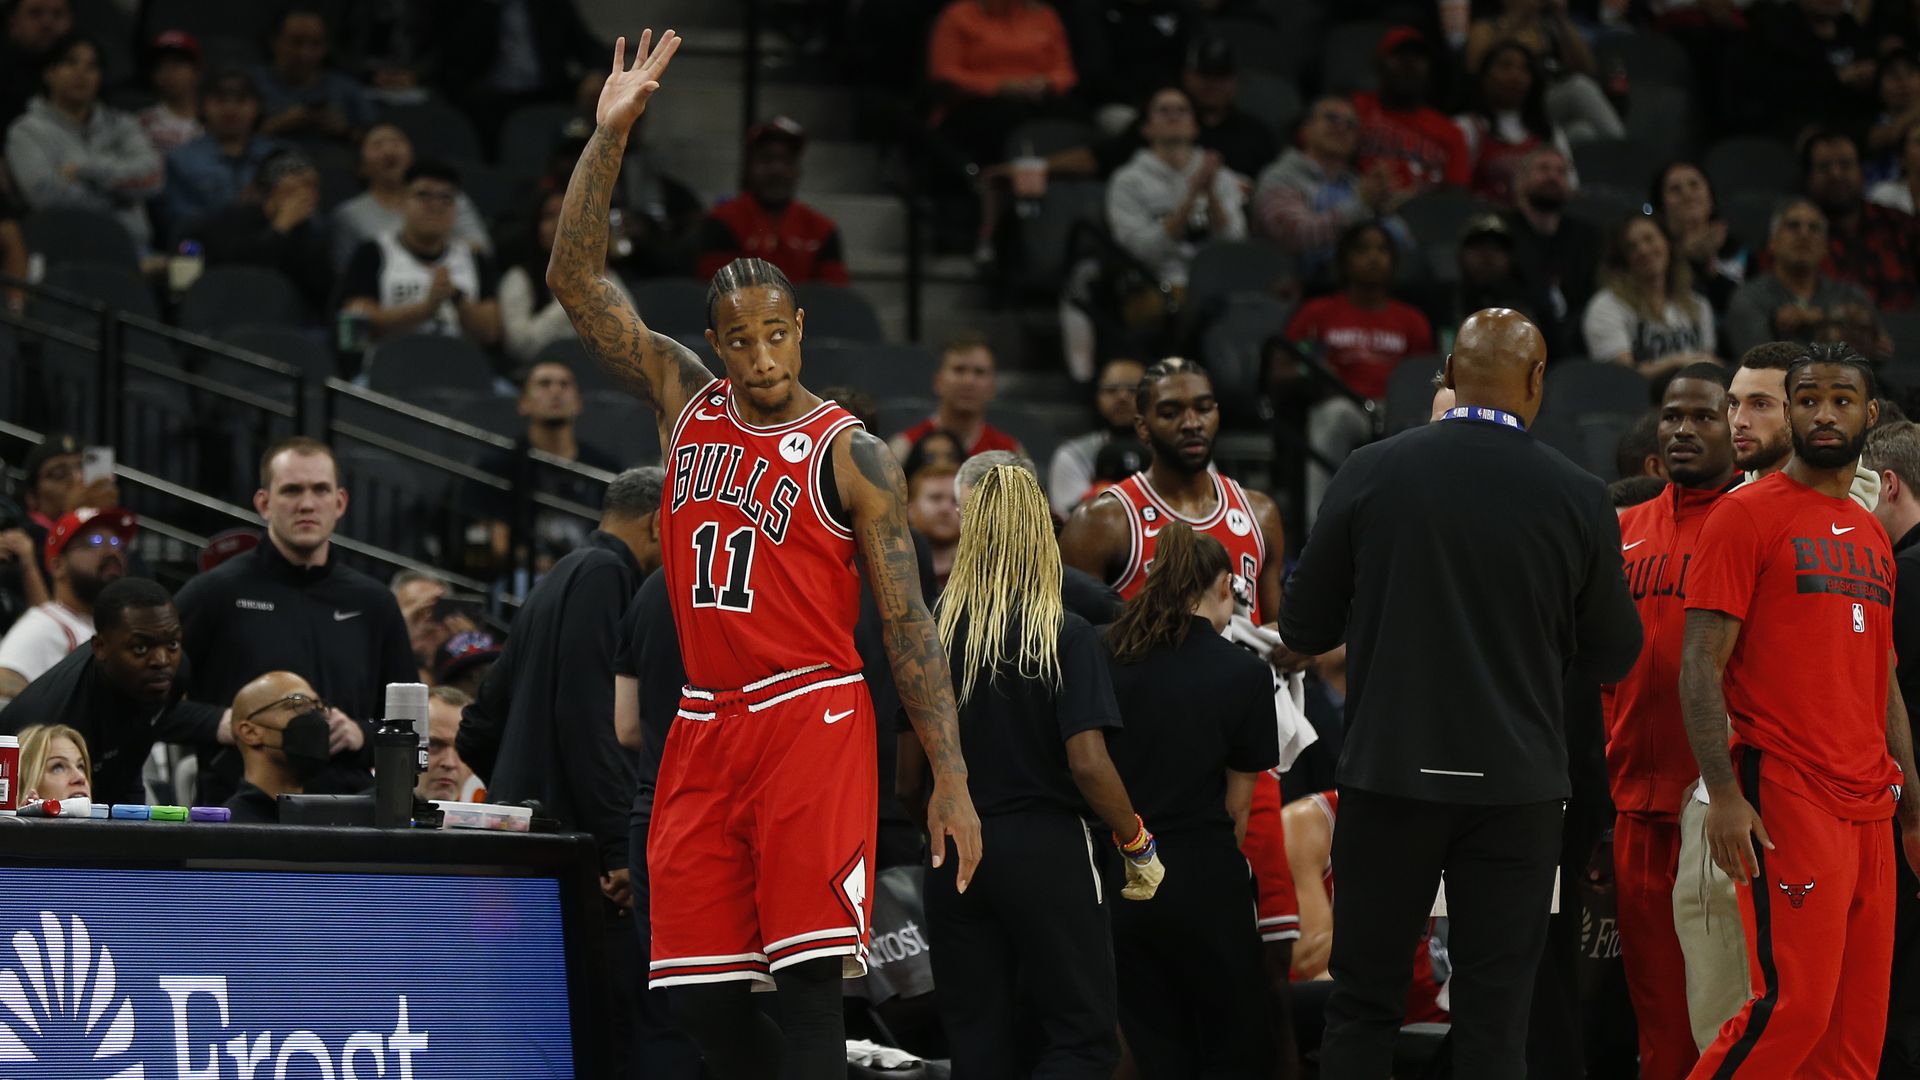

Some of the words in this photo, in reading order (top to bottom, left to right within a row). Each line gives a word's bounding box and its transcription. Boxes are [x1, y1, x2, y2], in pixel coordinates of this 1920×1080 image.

[710, 394, 727, 407] 6
[671, 442, 802, 546] BULLS
[1142, 506, 1157, 522] 6
[691, 521, 757, 614] 11
[1624, 553, 1691, 601] ULL
[1826, 578, 1884, 601] BASKETBALL
